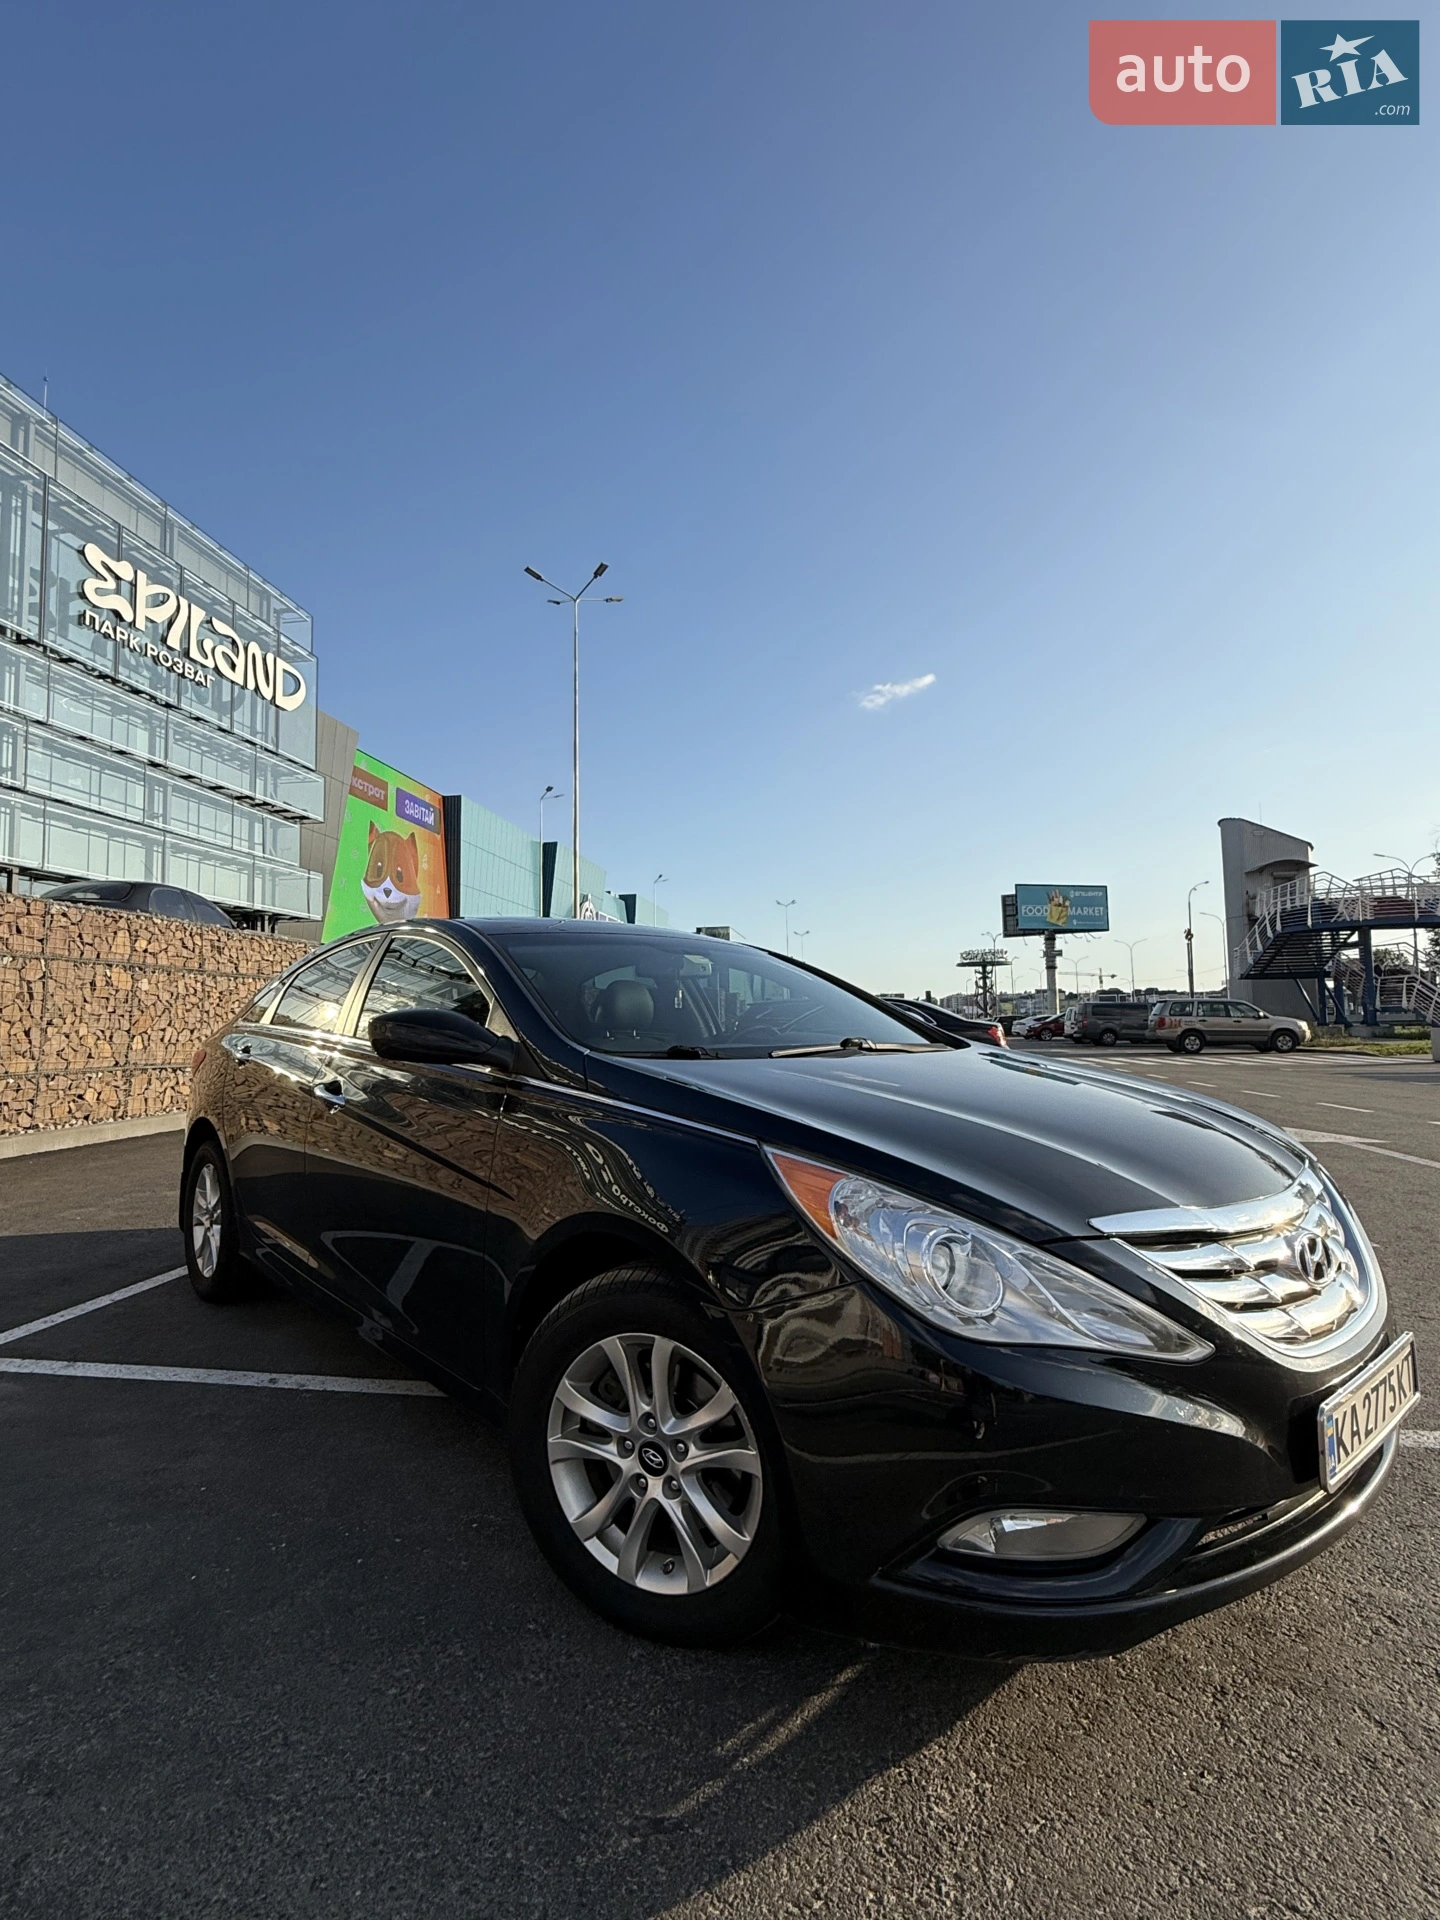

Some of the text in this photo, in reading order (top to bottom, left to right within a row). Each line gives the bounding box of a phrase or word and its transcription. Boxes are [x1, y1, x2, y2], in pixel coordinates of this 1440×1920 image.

[84, 609, 216, 689] ПАРК РОЗВАГ
[404, 799, 435, 826] ЗАВІТАЙ
[1021, 905, 1104, 917] FOOD MARKET
